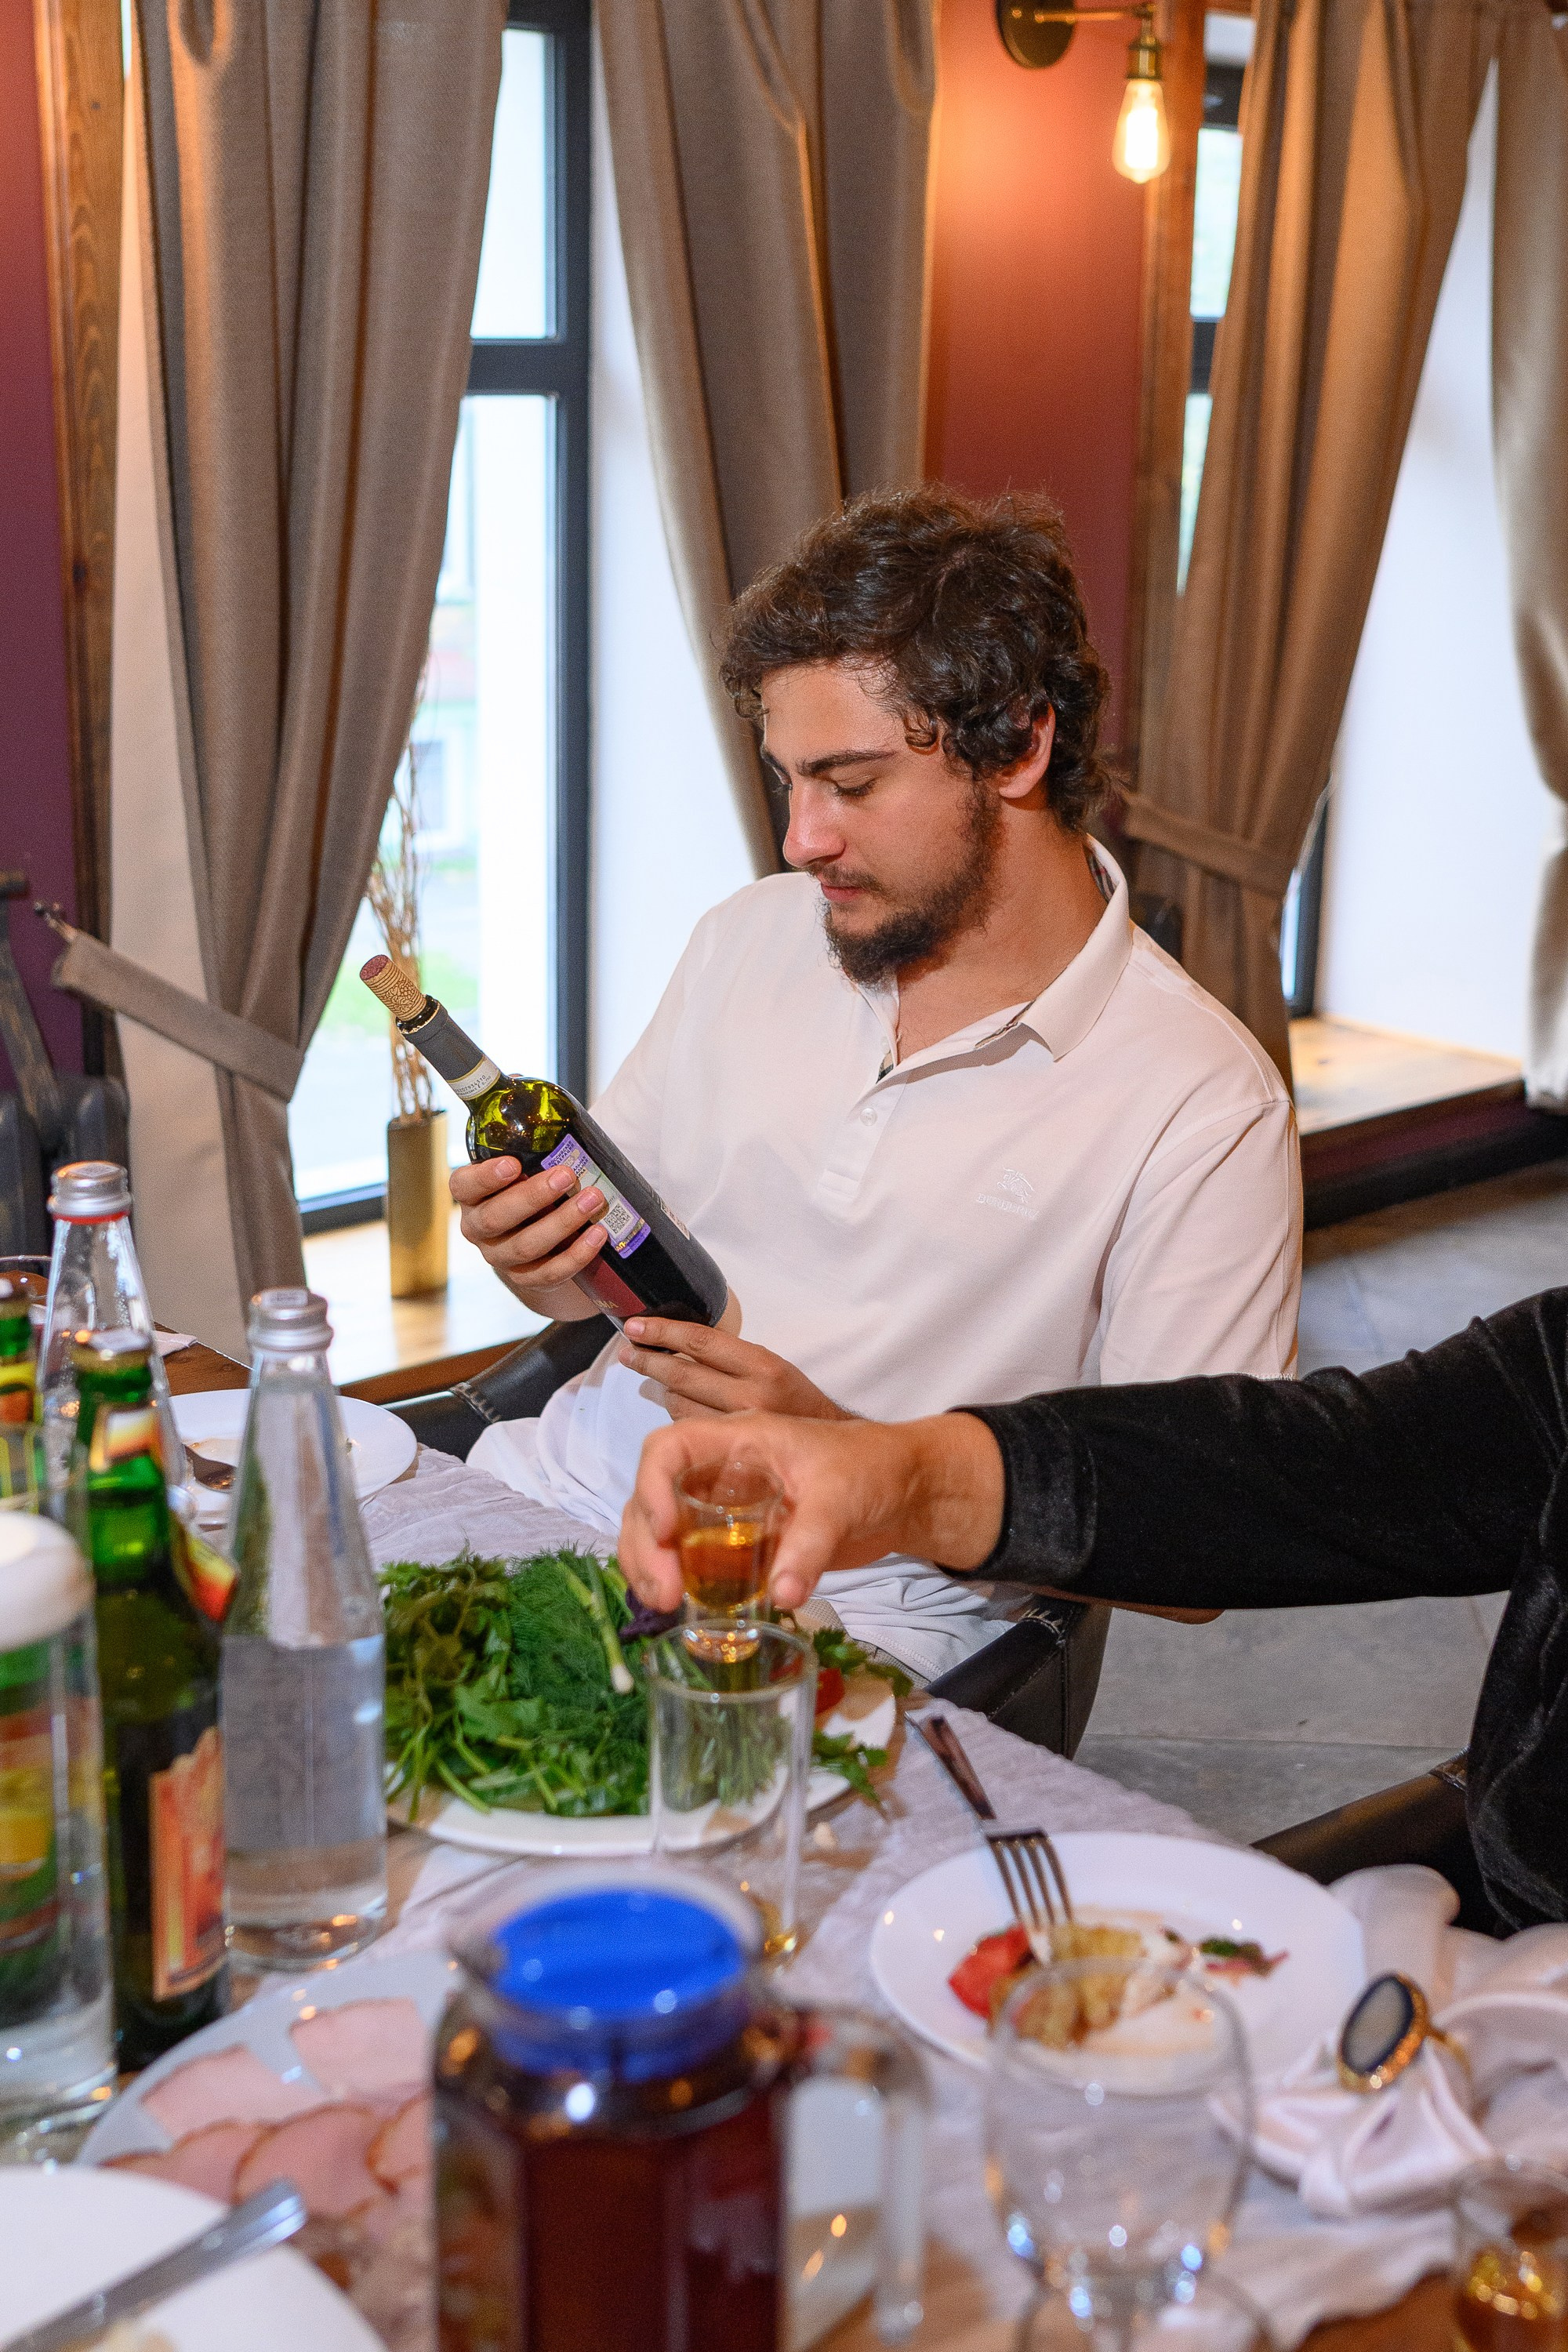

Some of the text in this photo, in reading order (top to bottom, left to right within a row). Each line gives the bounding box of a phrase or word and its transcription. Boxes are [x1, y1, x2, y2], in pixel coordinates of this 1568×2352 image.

[548, 1141, 572, 1167] РОССИЙСКАЯ
[573, 1156, 586, 1171] АЛЬНАЯ
[575, 1159, 589, 1174] АЛЬНАЯ
[577, 1169, 586, 1179] АРКА
[976, 1192, 1040, 1218] BURBERRY
